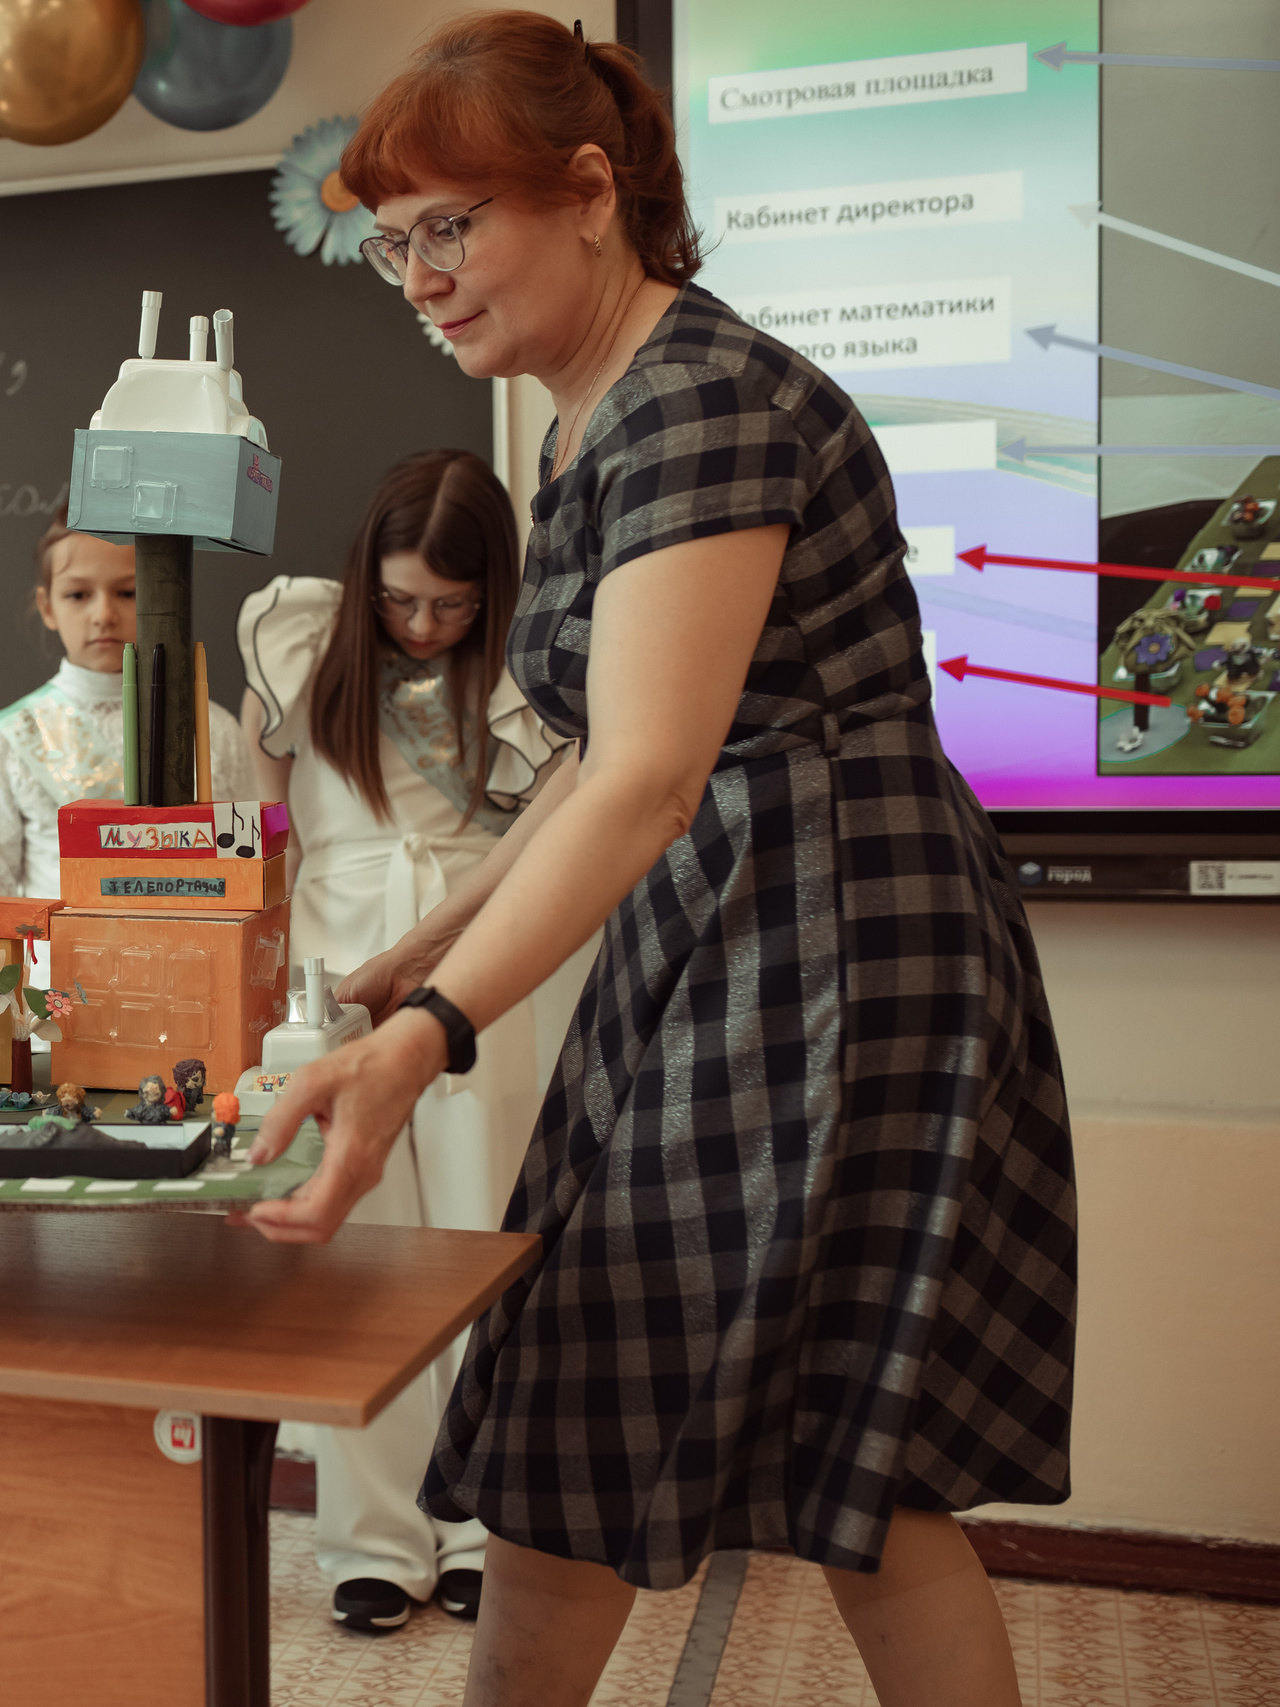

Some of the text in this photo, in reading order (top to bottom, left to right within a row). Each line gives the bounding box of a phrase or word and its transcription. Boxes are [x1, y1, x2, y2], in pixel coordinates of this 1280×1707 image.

[720, 66, 993, 111] Смотровая площадка
[726, 192, 975, 231] Кабинет директора
[739, 296, 995, 330] абинет математики
[843, 336, 918, 359] языка
[103, 826, 214, 850] МУЗЫКА
